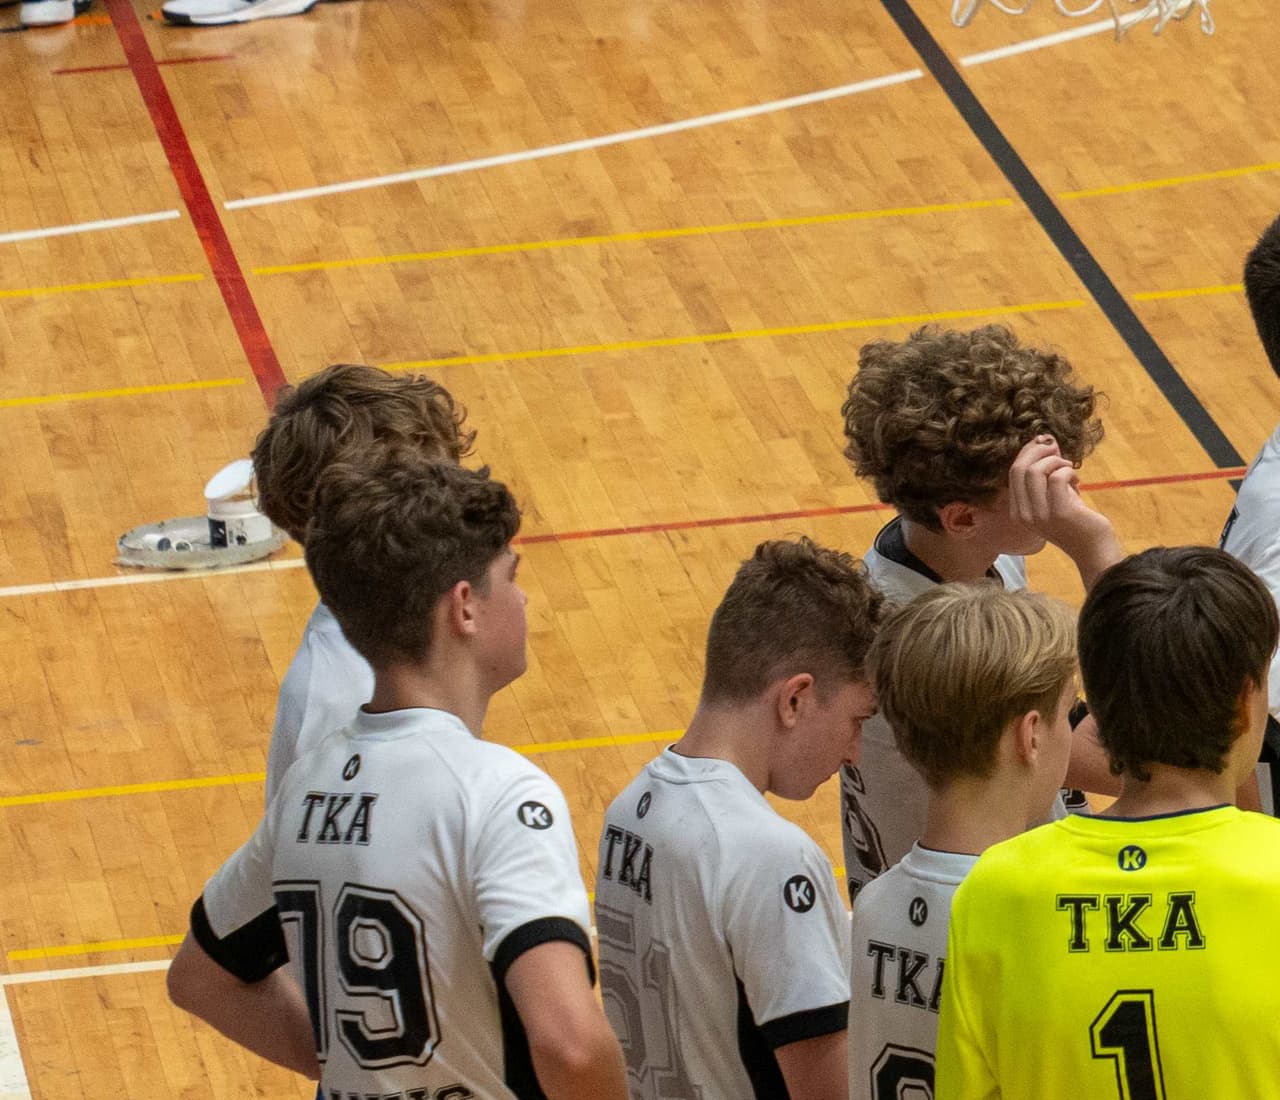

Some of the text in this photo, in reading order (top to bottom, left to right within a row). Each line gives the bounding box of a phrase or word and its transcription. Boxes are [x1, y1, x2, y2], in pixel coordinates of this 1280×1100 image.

[296, 791, 379, 845] TKA
[602, 823, 654, 906] TKA
[1055, 891, 1206, 953] TKA
